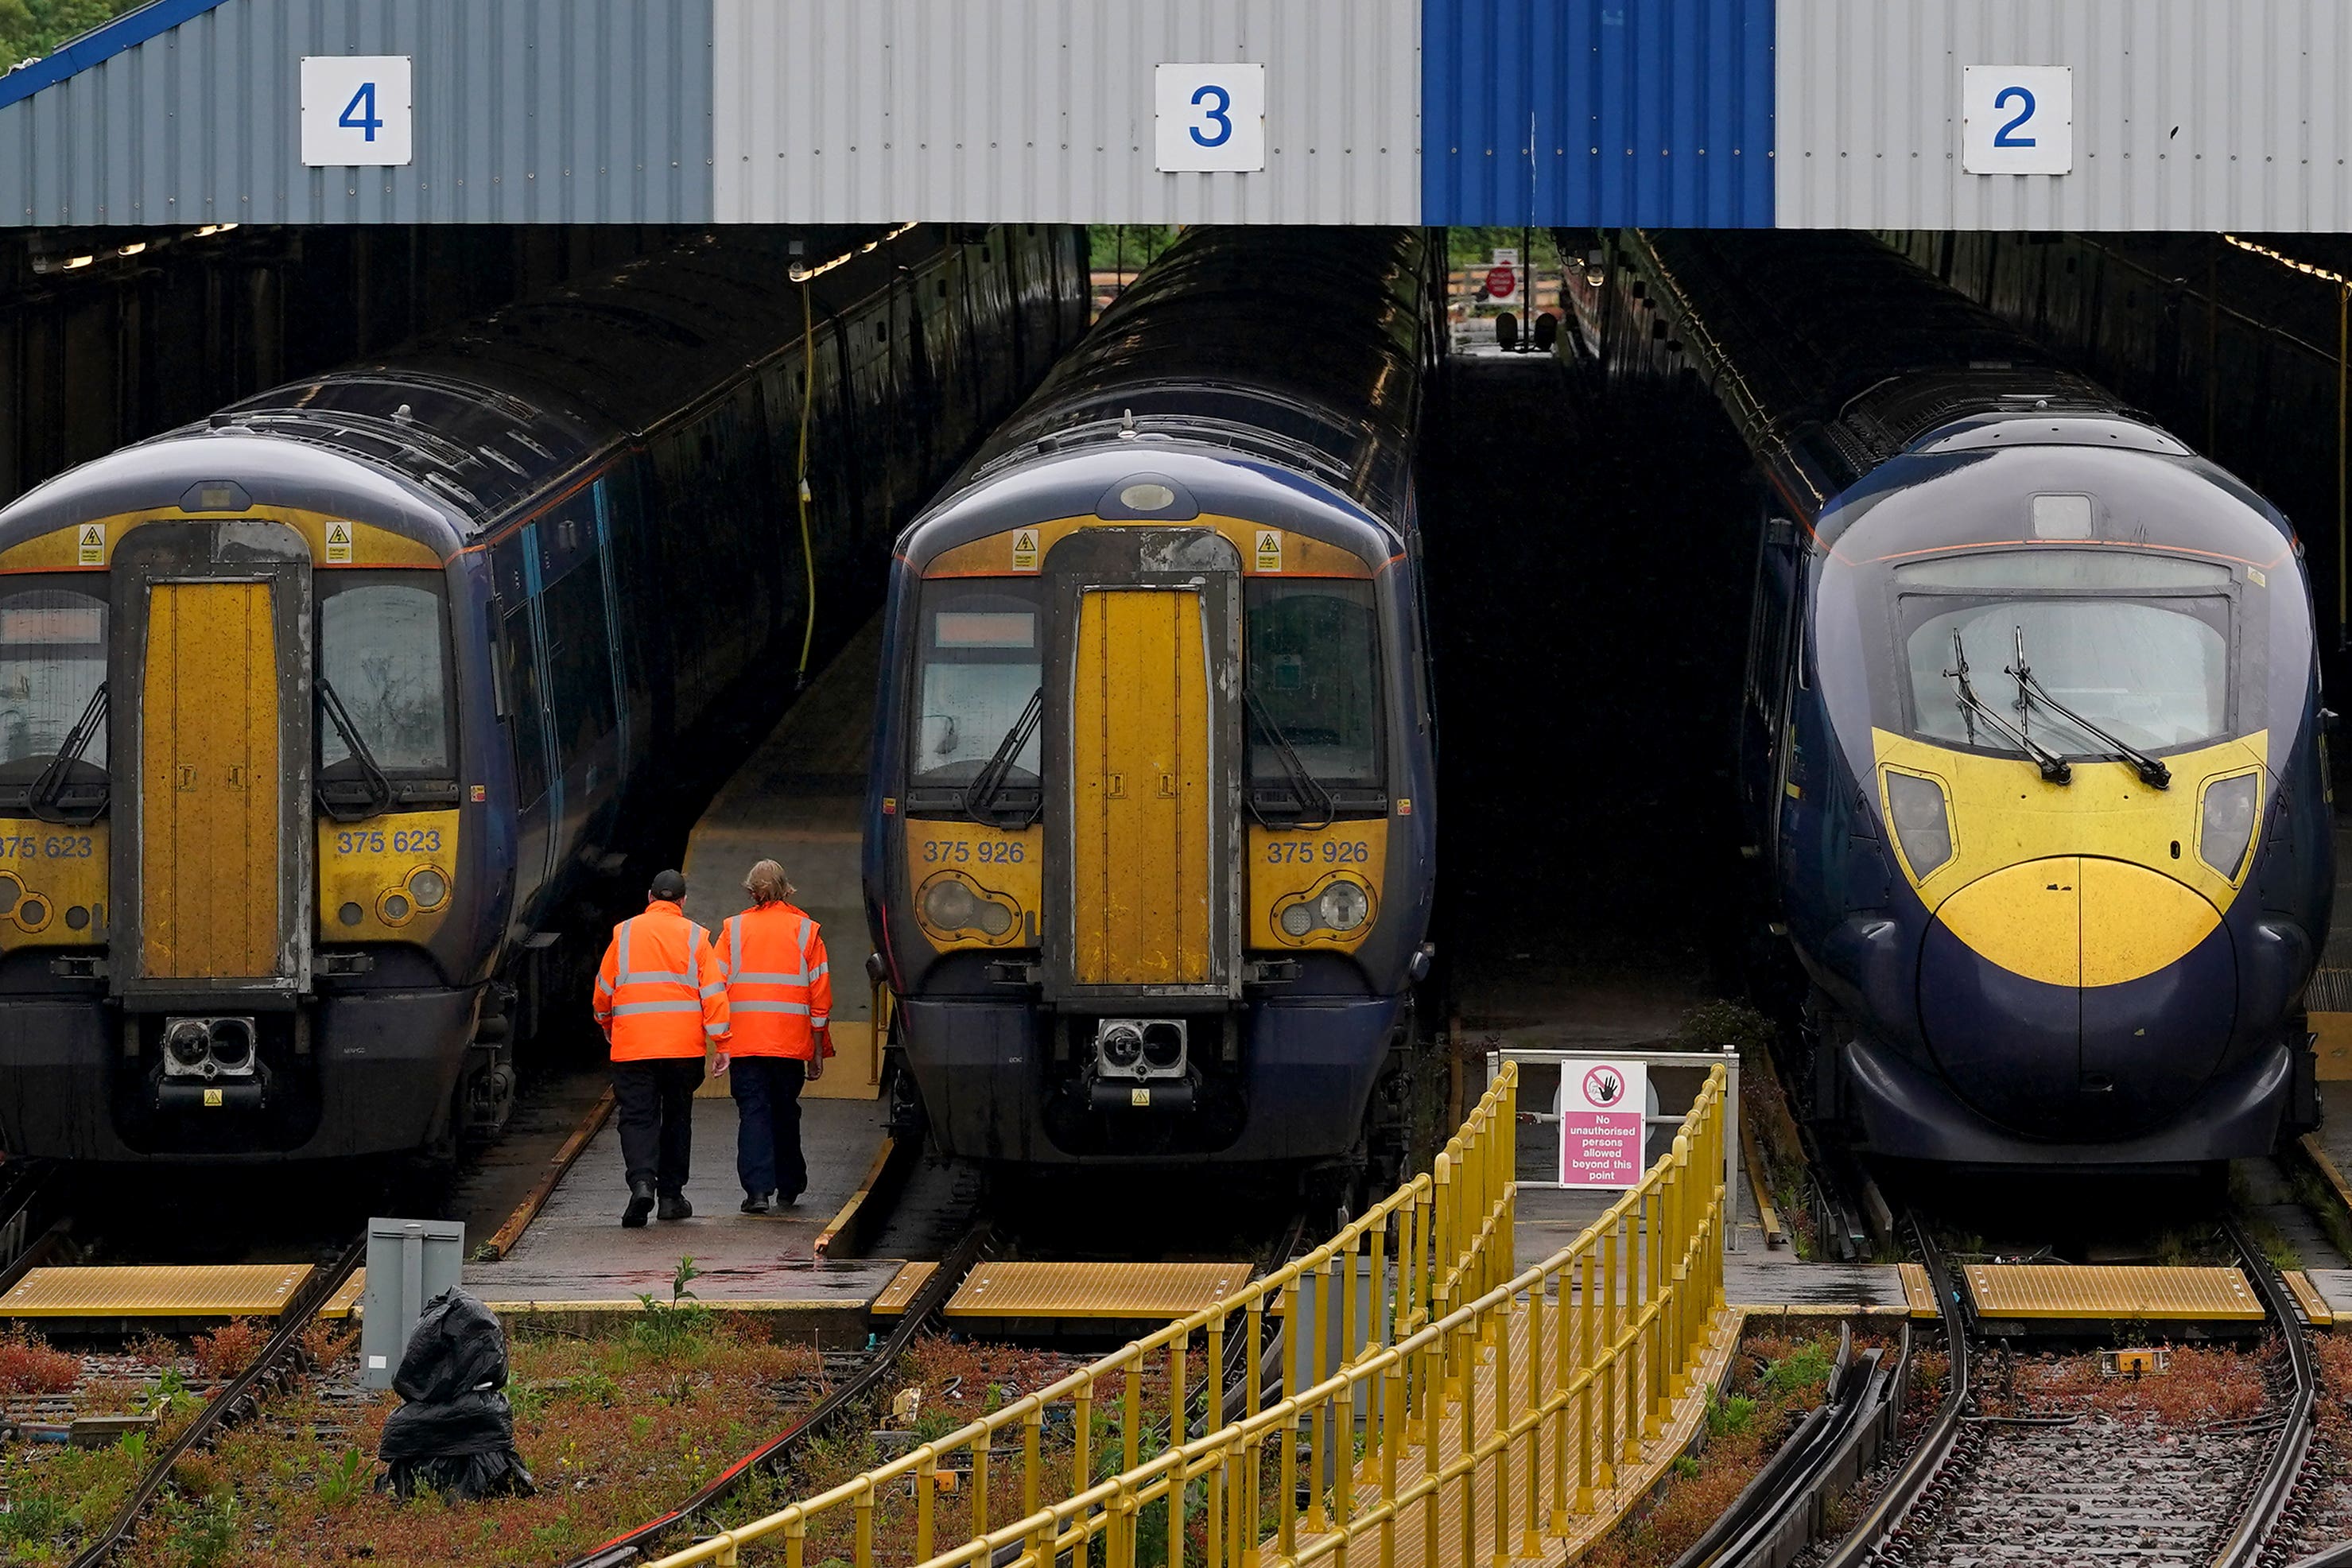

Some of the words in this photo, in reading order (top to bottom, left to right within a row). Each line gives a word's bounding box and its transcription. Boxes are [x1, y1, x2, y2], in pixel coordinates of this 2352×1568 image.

[339, 83, 382, 142] 4
[1190, 85, 1232, 147] 3
[1993, 87, 2036, 147] 2
[45, 836, 92, 858] 623
[337, 832, 385, 853] 375
[394, 830, 441, 852] 623
[923, 841, 970, 863] 375
[978, 841, 1024, 863] 926
[1267, 842, 1314, 864] 375
[1322, 841, 1368, 863] 926
[1596, 1115, 1610, 1124] No
[1570, 1127, 1636, 1136] unauthorised
[1582, 1138, 1623, 1147] persons
[1572, 1159, 1610, 1170] beyond
[1613, 1160, 1632, 1170] this
[1589, 1171, 1615, 1181] point
